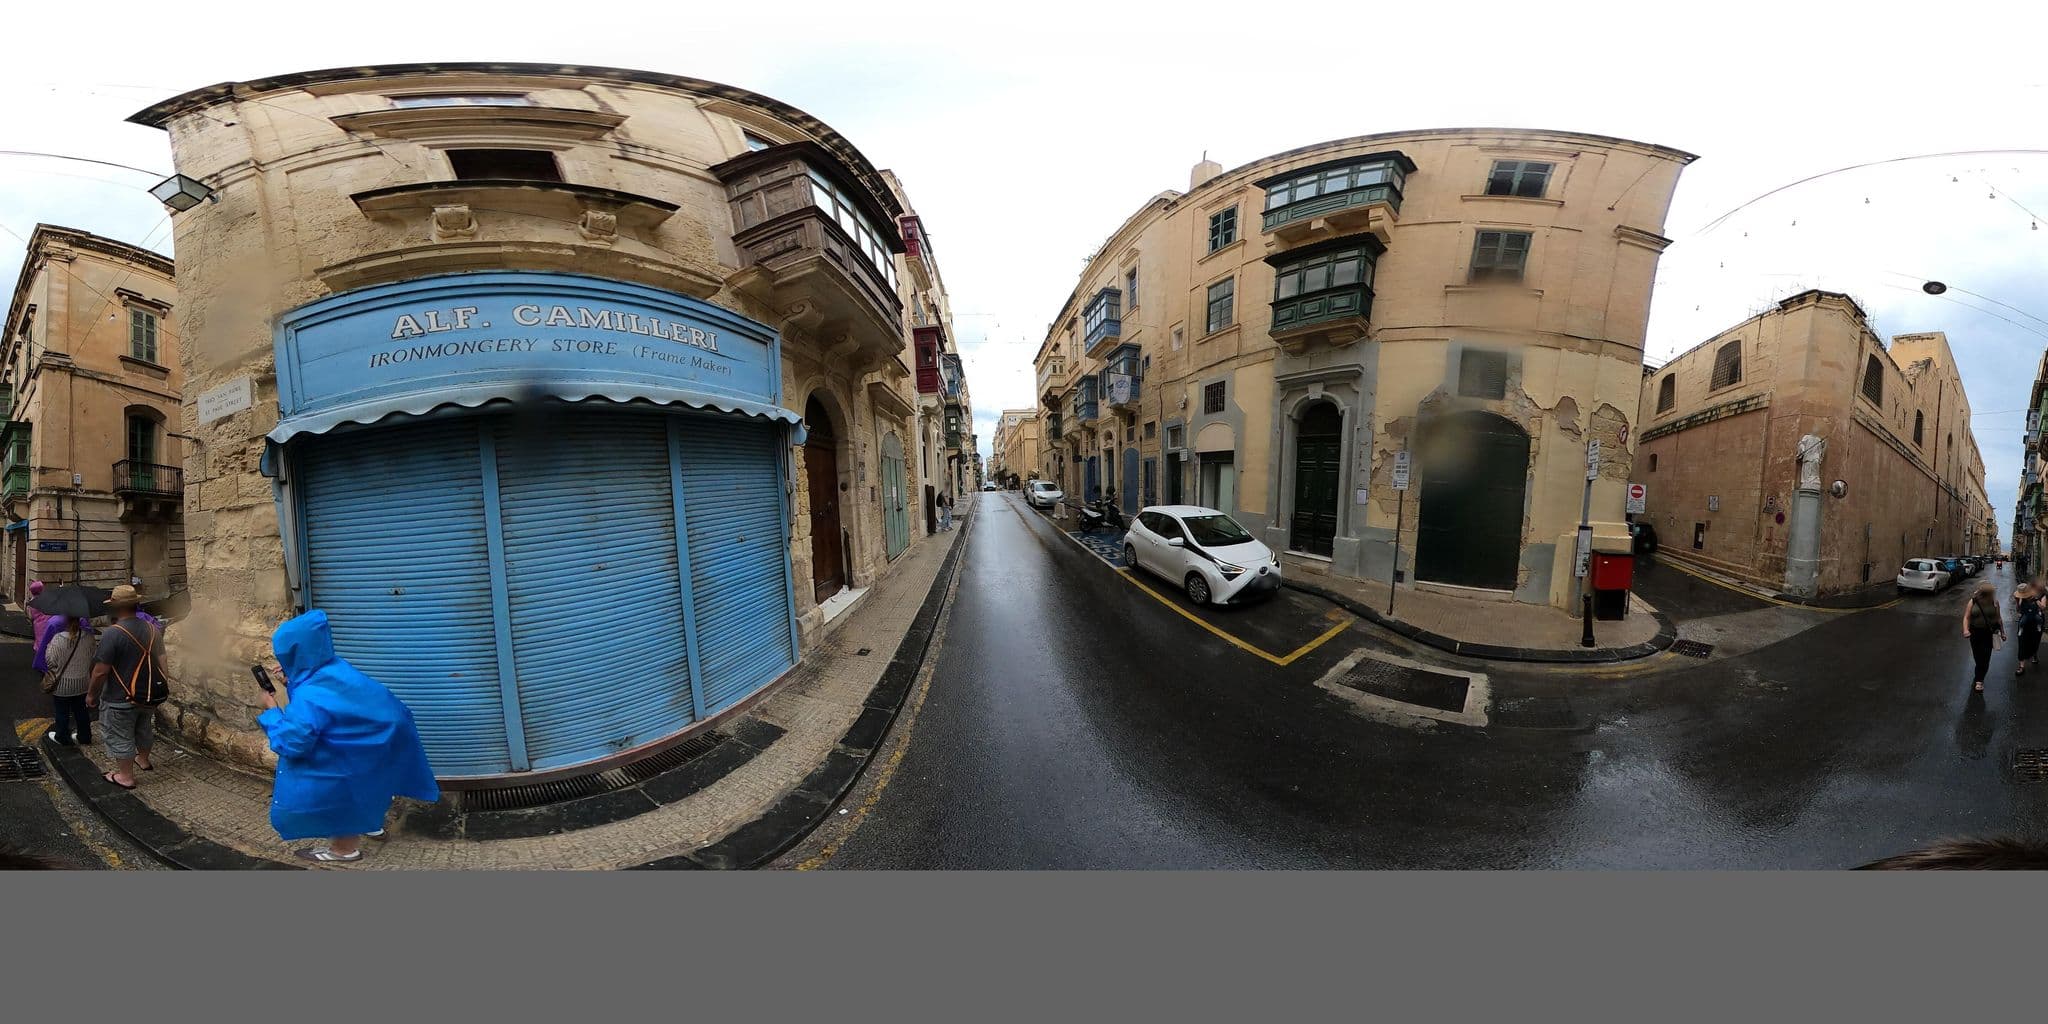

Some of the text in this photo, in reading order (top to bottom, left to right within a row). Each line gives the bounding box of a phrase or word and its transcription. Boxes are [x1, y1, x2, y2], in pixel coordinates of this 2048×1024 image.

[391, 304, 719, 352] ALF. CAMILLERI
[370, 338, 732, 377] IRONMONGERY STORE (Frame Maker)
